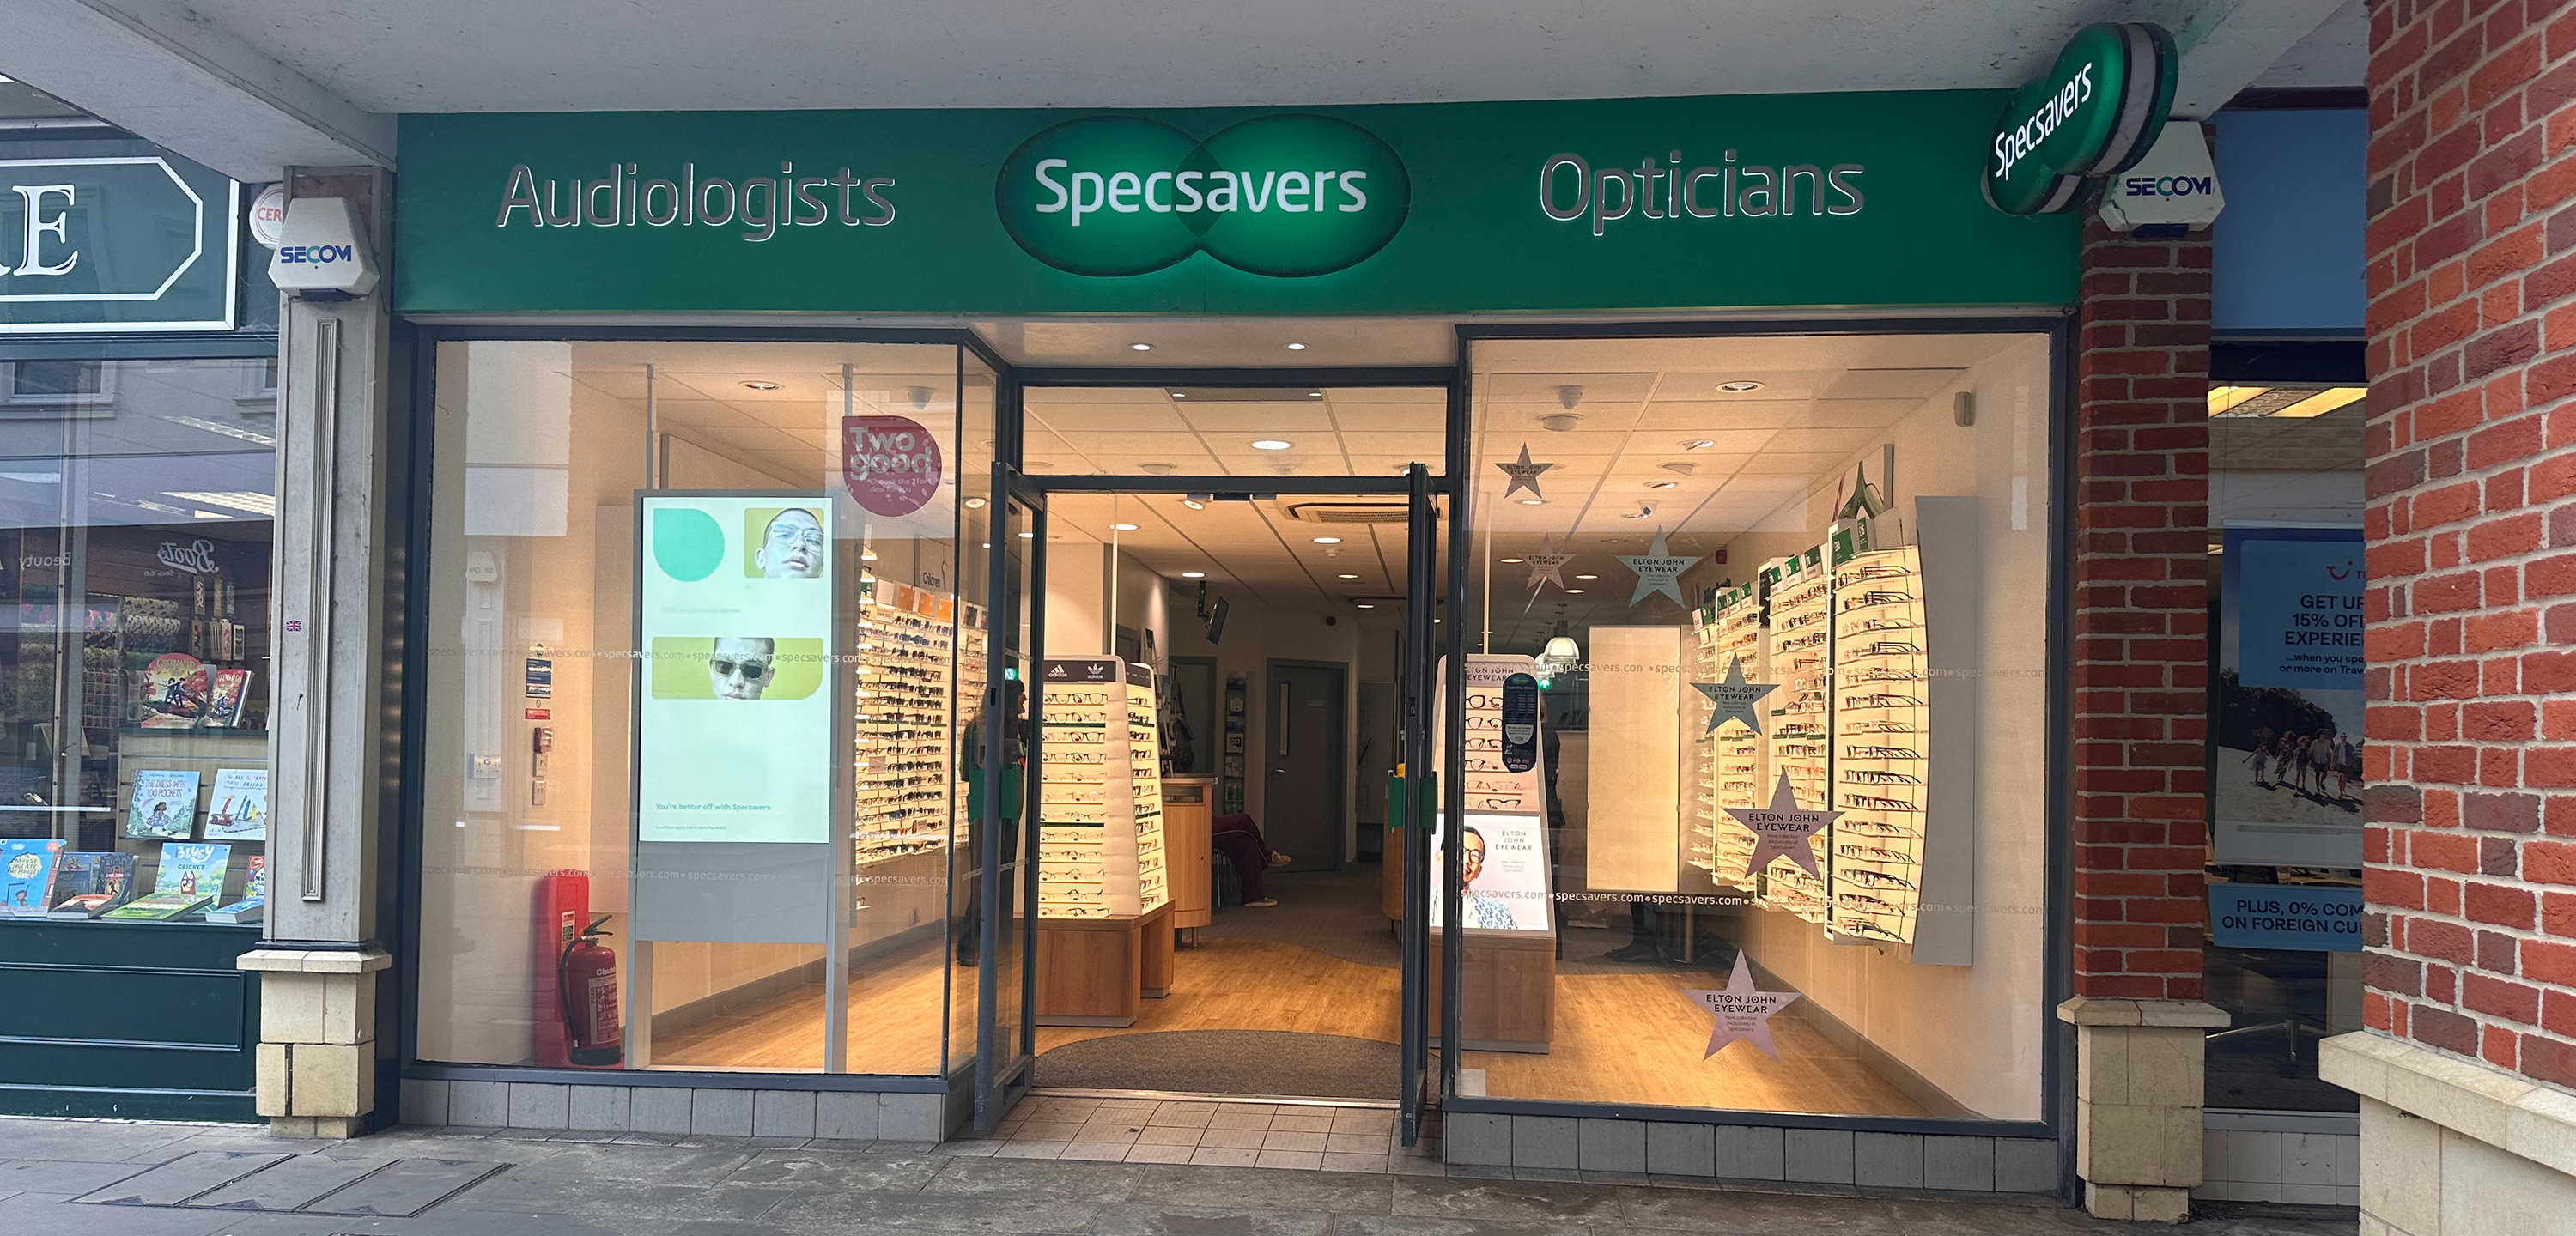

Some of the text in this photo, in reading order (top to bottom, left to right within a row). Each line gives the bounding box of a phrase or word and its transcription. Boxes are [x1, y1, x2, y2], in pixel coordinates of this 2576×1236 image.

[1995, 62, 2092, 181] Specsavers
[1035, 158, 1367, 227] Specsavers
[1540, 148, 1865, 236] Opticians
[2125, 176, 2211, 197] SECOM
[495, 161, 896, 242] Audiologists
[0, 185, 79, 276] E
[280, 245, 352, 264] SECOM
[849, 427, 915, 451] Two
[850, 446, 932, 481] good
[1632, 558, 1660, 566] ELTON
[923, 572, 941, 588] Children
[2300, 594, 2338, 609] GET
[2293, 613, 2329, 627] 15%
[2284, 631, 2364, 646] EXPERIE
[603, 649, 684, 662] specsavers.com
[2324, 655, 2342, 665] you
[145, 779, 155, 788] THE
[155, 779, 173, 788] DRESS
[158, 789, 184, 798] POCKETS
[1748, 813, 1820, 822] ELTON JOHN
[1756, 823, 1810, 832] EYEWEAR
[176, 845, 215, 863] BLUEY
[1555, 892, 1644, 904] specsavers.com
[1652, 894, 1742, 906] specsavers.com
[2236, 900, 2284, 916] PLUS,
[2288, 901, 2318, 916] 0%
[2221, 916, 2363, 934] ON FOREIGN CU
[1706, 994, 1777, 1004] ELTON JOHN
[1714, 1004, 1768, 1014] EYEWEAR
